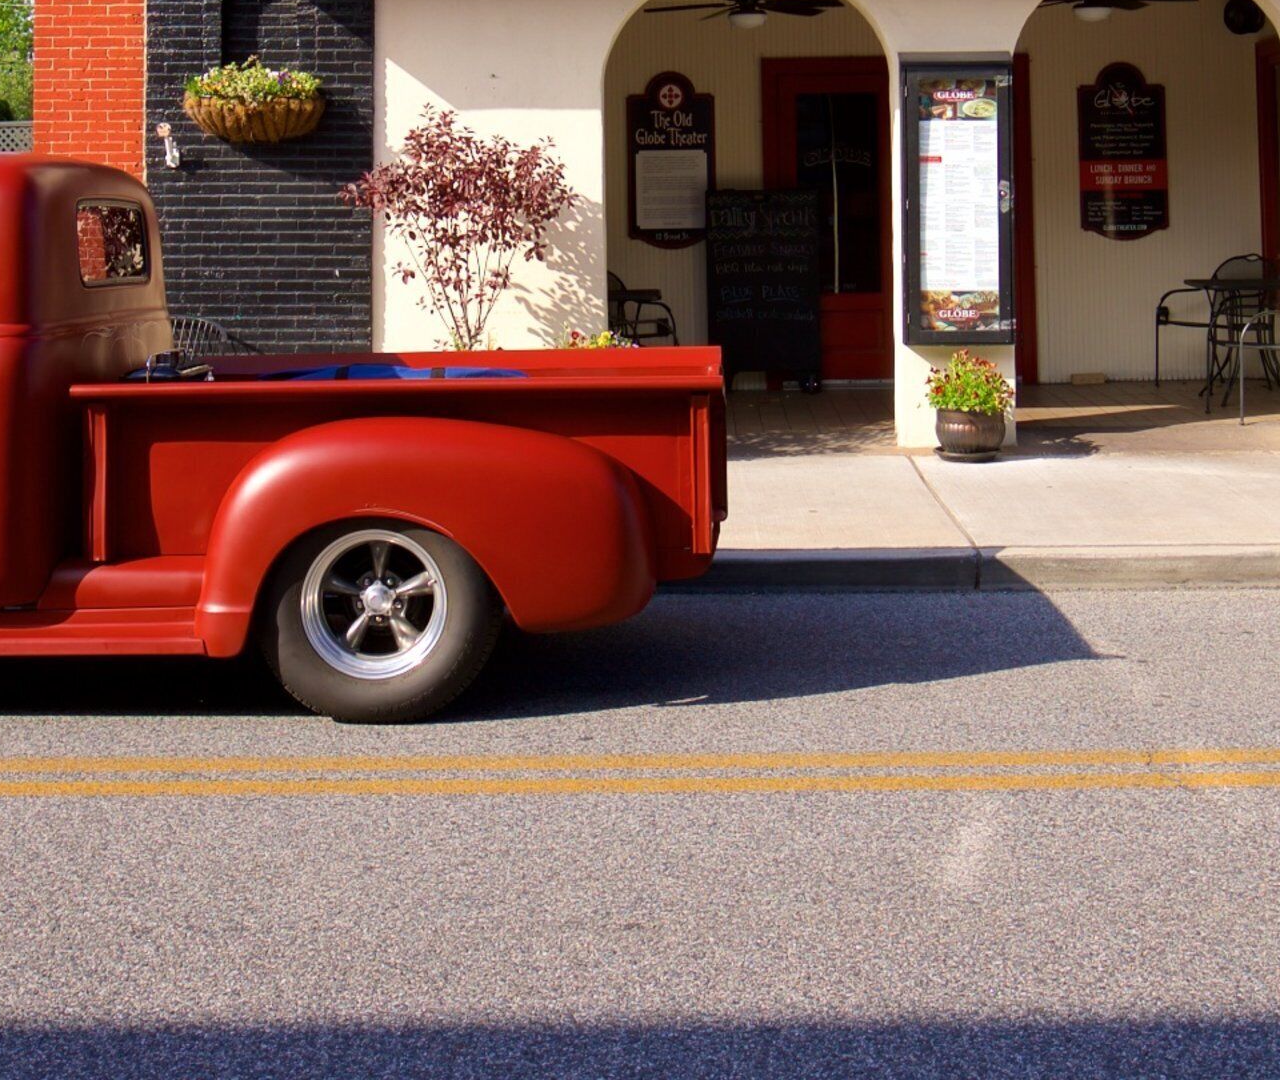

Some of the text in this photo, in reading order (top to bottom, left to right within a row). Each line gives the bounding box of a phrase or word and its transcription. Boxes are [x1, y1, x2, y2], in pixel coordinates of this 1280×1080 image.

[937, 91, 974, 99] GLOBE
[650, 110, 693, 129] The Old
[635, 127, 707, 147] Globe Theater
[939, 310, 976, 318] GLOBE
